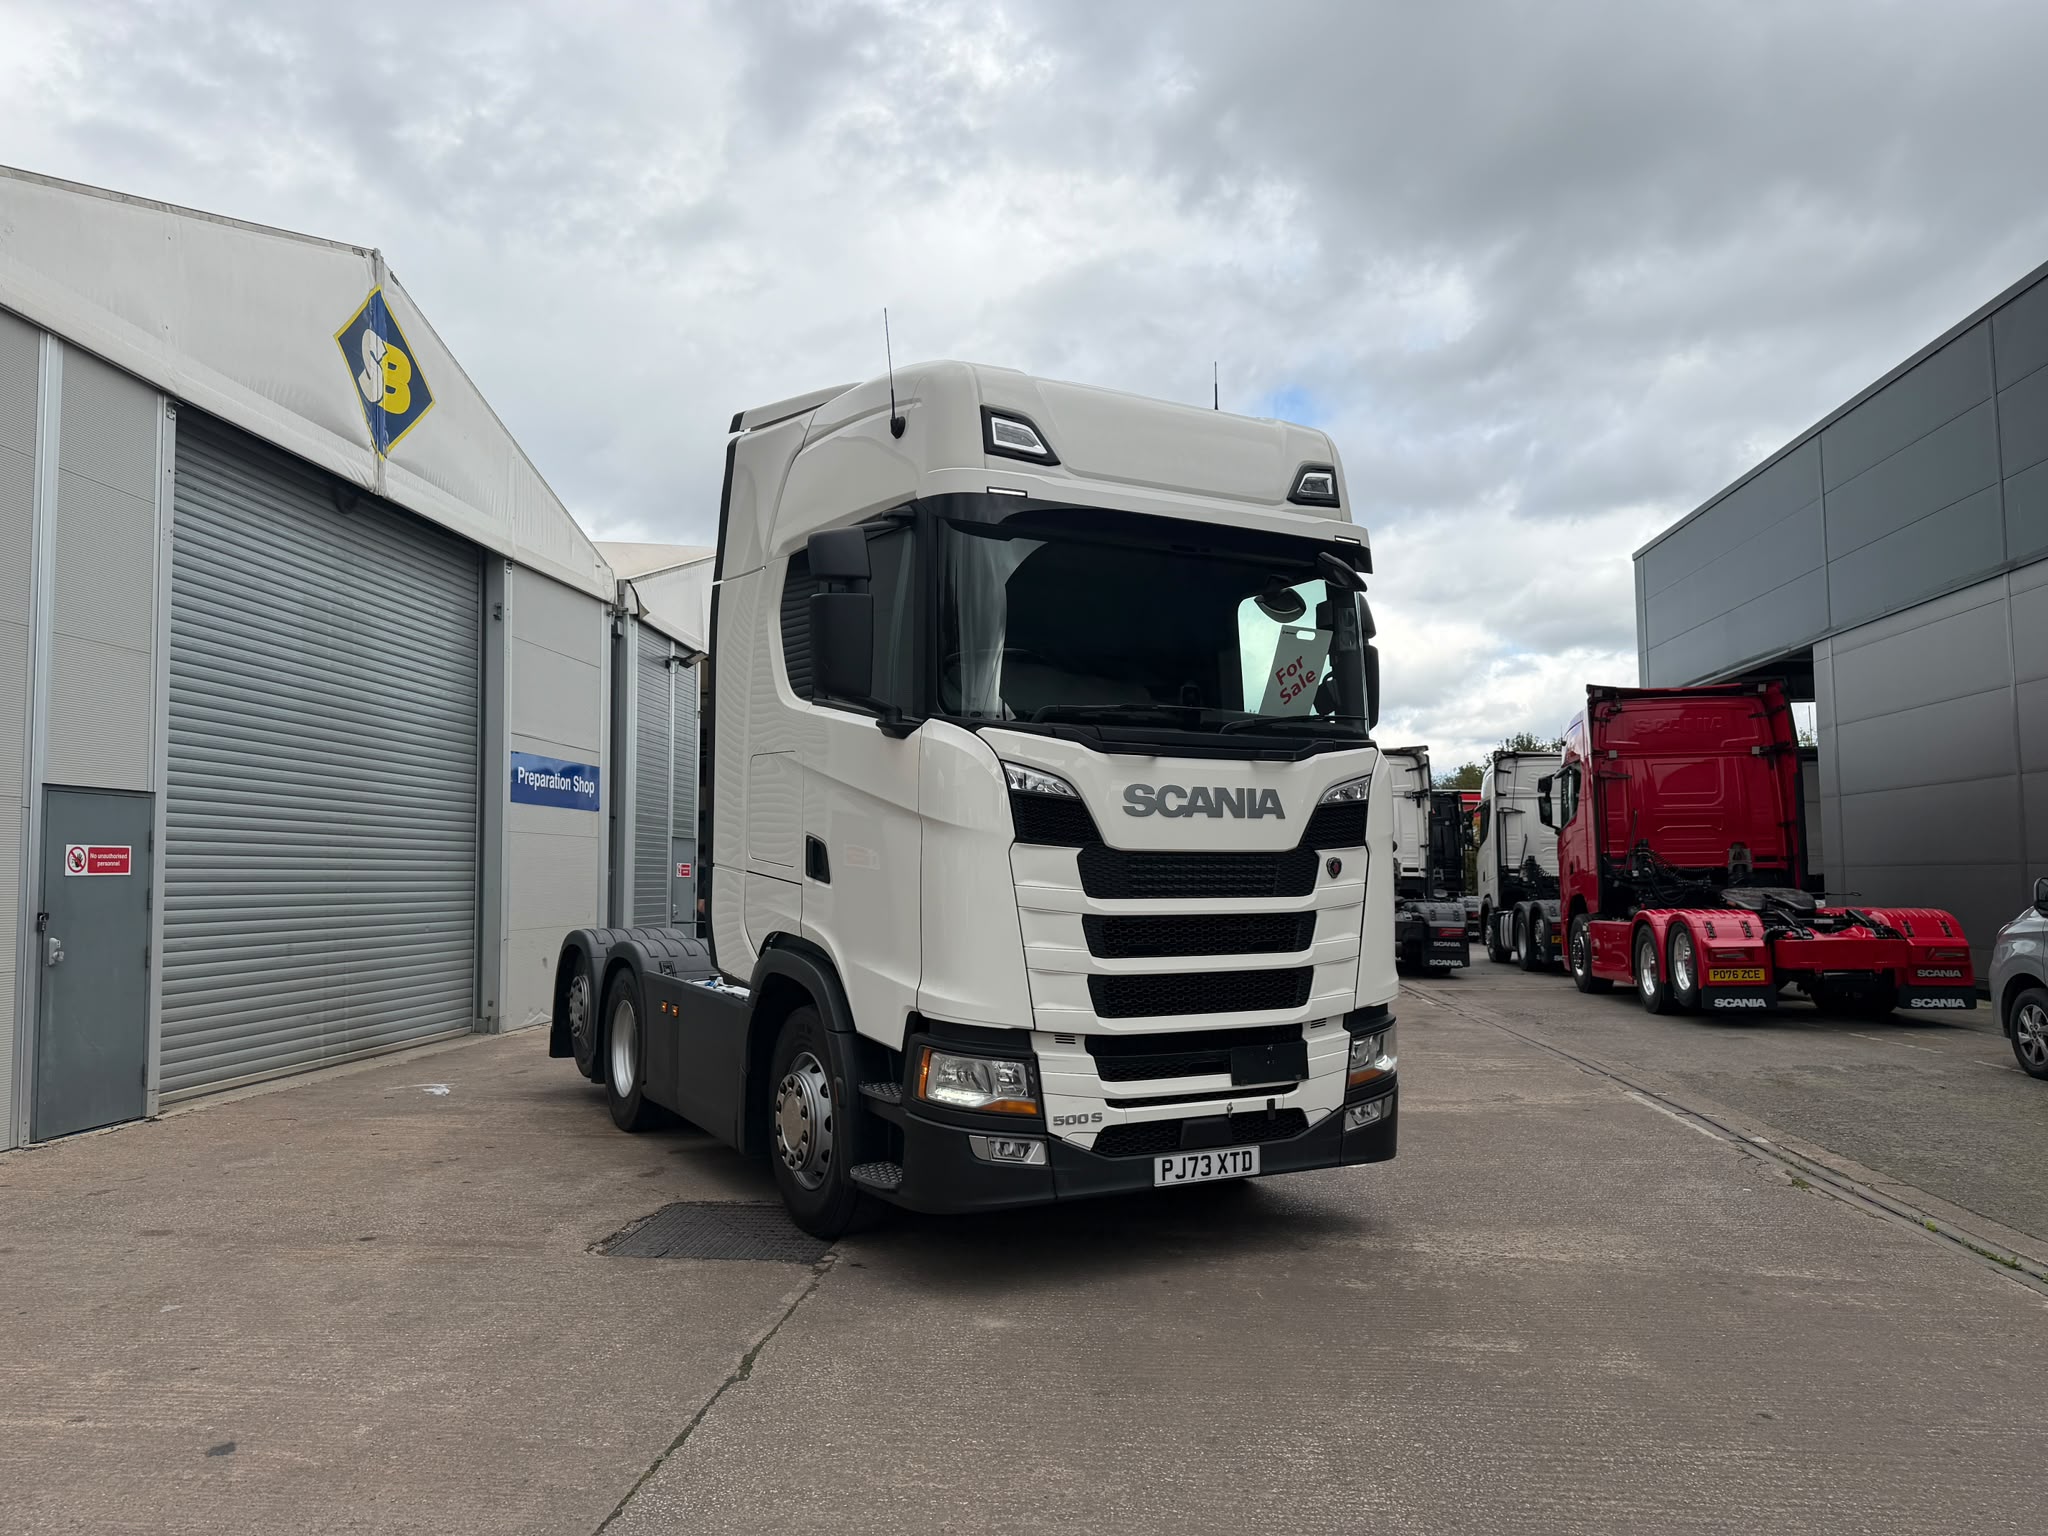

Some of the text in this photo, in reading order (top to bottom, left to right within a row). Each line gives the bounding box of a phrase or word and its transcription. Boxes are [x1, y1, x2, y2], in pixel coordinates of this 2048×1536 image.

[1275, 655, 1303, 686] For
[1280, 670, 1316, 705] Sale
[518, 766, 595, 798] Preparation Shop
[1122, 783, 1286, 820] SCANIA
[96, 860, 121, 868] personnel
[1741, 970, 1761, 979] ZCE
[1917, 969, 1962, 977] SCANIA
[1714, 998, 1767, 1008] SCANIA
[1910, 998, 1966, 1008] SCANIA
[1161, 1150, 1253, 1182] PJ73 XTD
